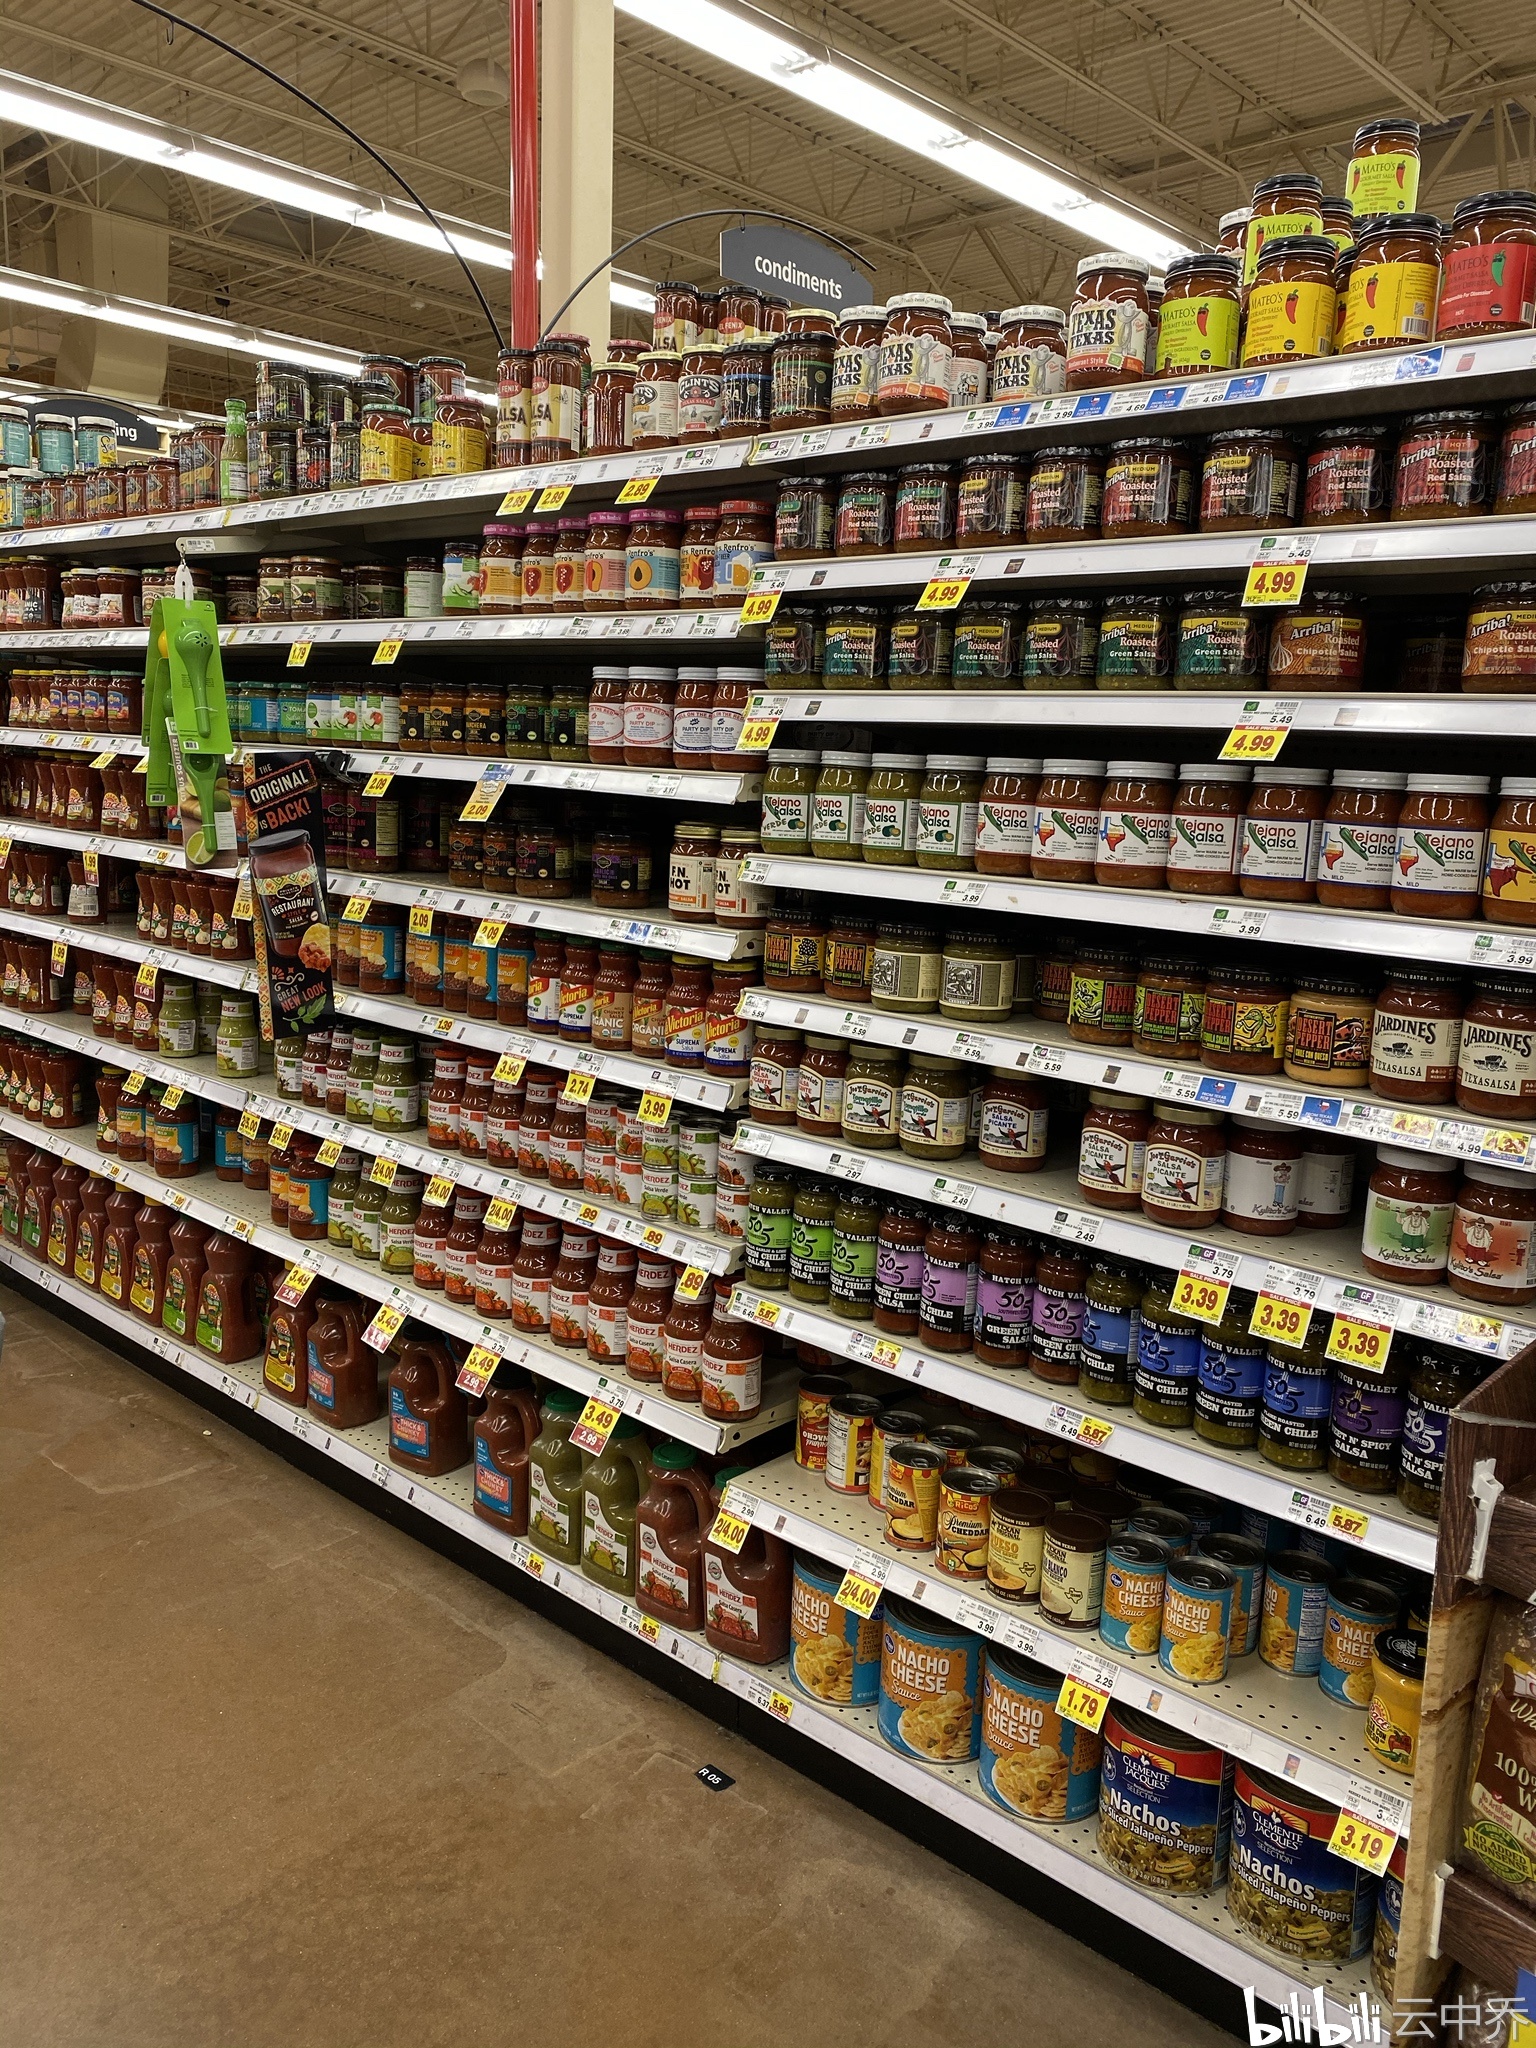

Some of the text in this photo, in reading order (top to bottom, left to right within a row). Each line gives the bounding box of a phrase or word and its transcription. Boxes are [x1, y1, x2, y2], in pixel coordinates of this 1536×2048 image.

[1362, 162, 1396, 175] MATEO'S
[1266, 223, 1304, 236] MATEO'S
[1448, 256, 1489, 275] MATEO'S
[754, 254, 843, 300] condiments
[1250, 291, 1283, 311] MATEO'S
[1072, 308, 1117, 334] TEXAS
[1162, 304, 1196, 324] MATEO'S
[1070, 330, 1115, 348] TEXAS
[880, 343, 914, 363] TEXAS
[879, 360, 913, 376] TEXAS
[680, 376, 720, 395] CLINT'S
[1126, 403, 1145, 413] 4.69
[1203, 394, 1224, 405] 4.69
[1054, 411, 1073, 420] 3.99
[115, 423, 138, 441] ing
[978, 420, 995, 430] 3.99
[1399, 442, 1442, 470] Arriba!
[1428, 458, 1475, 470] Roasted
[1306, 453, 1340, 480] Arriba!
[1427, 472, 1472, 482] Red Salsa
[1120, 480, 1157, 492] Roasted
[1288, 548, 1312, 560] 5.49
[957, 566, 976, 576] 5.49
[1254, 570, 1296, 595] 4.99
[927, 585, 960, 603] 4.99
[747, 599, 773, 617] 4.99
[1181, 618, 1220, 644] Arriba!
[1291, 618, 1336, 641] Arriba!
[1470, 613, 1513, 638] Arriba!
[967, 640, 1001, 652] Roasted
[1120, 635, 1158, 647] Roasted
[1473, 644, 1514, 655] Chipotle
[1109, 650, 1156, 659] Green Salsa
[745, 725, 771, 744] 4.99
[1232, 734, 1275, 753] 4.99
[258, 763, 273, 776] THE
[250, 769, 310, 805] ORIGINAL
[369, 778, 387, 791] 2.09
[468, 804, 489, 818] 2.09
[769, 797, 801, 811] Tejano
[773, 807, 803, 817] Salsa
[259, 796, 312, 831] IS BACK!
[990, 806, 1028, 820] Tejano
[996, 816, 1028, 830] Salsa
[1182, 818, 1225, 834] Tejano
[1189, 830, 1225, 844] Salsa
[1424, 833, 1475, 850] Tejano
[1437, 846, 1475, 861] Salsa
[271, 896, 316, 918] RESTAURANT
[962, 894, 980, 904] 3.99
[412, 913, 429, 928] 2.09
[1238, 925, 1261, 936] 3.99
[837, 946, 864, 962] DESERT
[1507, 954, 1533, 966] 3.99
[836, 957, 863, 972] PEPPER
[140, 965, 156, 982] 1.99
[280, 981, 328, 1014] NEW LOOK
[667, 1010, 704, 1032] Victoria
[706, 1019, 741, 1040] Victoria
[1297, 1016, 1334, 1037] DESERT
[1374, 1014, 1438, 1045] JARDINES
[852, 1027, 867, 1037] 5.59
[1463, 1025, 1535, 1058] JARDINES
[498, 1062, 520, 1078] 3.99
[1374, 1057, 1423, 1078] TEXASALSA
[569, 1080, 590, 1096] 2.74
[1464, 1070, 1518, 1092] TEXASALSA
[1176, 1088, 1197, 1100] 5.59
[643, 1101, 666, 1119] 3.99
[1278, 1109, 1300, 1120] 5.59
[845, 1169, 862, 1180] 2.97
[1152, 1165, 1187, 1180] PICANTE
[1156, 1160, 1183, 1173] SALSA
[951, 1195, 969, 1206] 2.49
[1074, 1230, 1096, 1243] 2.49
[748, 1255, 772, 1269] SALSA
[1378, 1246, 1437, 1265] Kylito's Salsa
[289, 1269, 311, 1287] 3.49
[1212, 1265, 1235, 1280] 3.79
[282, 1287, 297, 1301] 2.99
[877, 1294, 905, 1309] SALSA
[893, 1291, 922, 1302] CHILE
[1180, 1283, 1219, 1312] 3.39
[377, 1308, 401, 1331] 3.49
[758, 1307, 777, 1321] 5.87
[1261, 1300, 1302, 1335] 3.39
[667, 1341, 699, 1355] HERDEZ
[1337, 1326, 1380, 1358] 3.39
[469, 1352, 495, 1373] 3.49
[1043, 1348, 1078, 1361] SALSA
[463, 1376, 481, 1391] 2.99
[609, 1395, 626, 1409] 3.79
[584, 1403, 614, 1430] 3.49
[1221, 1404, 1256, 1419] CHILE
[579, 1430, 599, 1447] 2.99
[1060, 1425, 1078, 1438] 6.49
[1403, 1407, 1443, 1455] 505
[1402, 1456, 1434, 1481] SALSA
[740, 1505, 756, 1519] 2.99
[1305, 1513, 1327, 1528] 6.49
[713, 1517, 746, 1546] 2/4.00
[951, 1523, 991, 1538] CHEDDAR
[1332, 1514, 1363, 1533] 5.87
[870, 1567, 887, 1581] 2.99
[838, 1578, 878, 1609] 2/4.00
[1126, 1577, 1165, 1594] NACHO
[1118, 1589, 1163, 1609] CHEESE
[897, 1643, 951, 1677] NACHO
[890, 1658, 948, 1696] CHEESE
[890, 1678, 922, 1702] Sauce
[757, 1695, 771, 1710] 6.37
[771, 1699, 789, 1716] 5.99
[992, 1687, 1045, 1729] NACHO
[1066, 1686, 1100, 1719] 1.79
[987, 1703, 1042, 1749] CHEESE
[698, 1767, 722, 1785] R 05
[1122, 1754, 1171, 1784] CLEMENTE
[1110, 1786, 1182, 1837] Nachos
[1107, 1806, 1215, 1858] Sliced Jalapeño Peppers
[1251, 1809, 1305, 1845] CLEMENTE
[1340, 1823, 1384, 1860] 3.19
[1472, 1830, 1488, 1845] NO
[1489, 1838, 1528, 1866] ADDED
[1472, 1840, 1530, 1875] NONSENSE
[1239, 1843, 1317, 1903] Nachos
